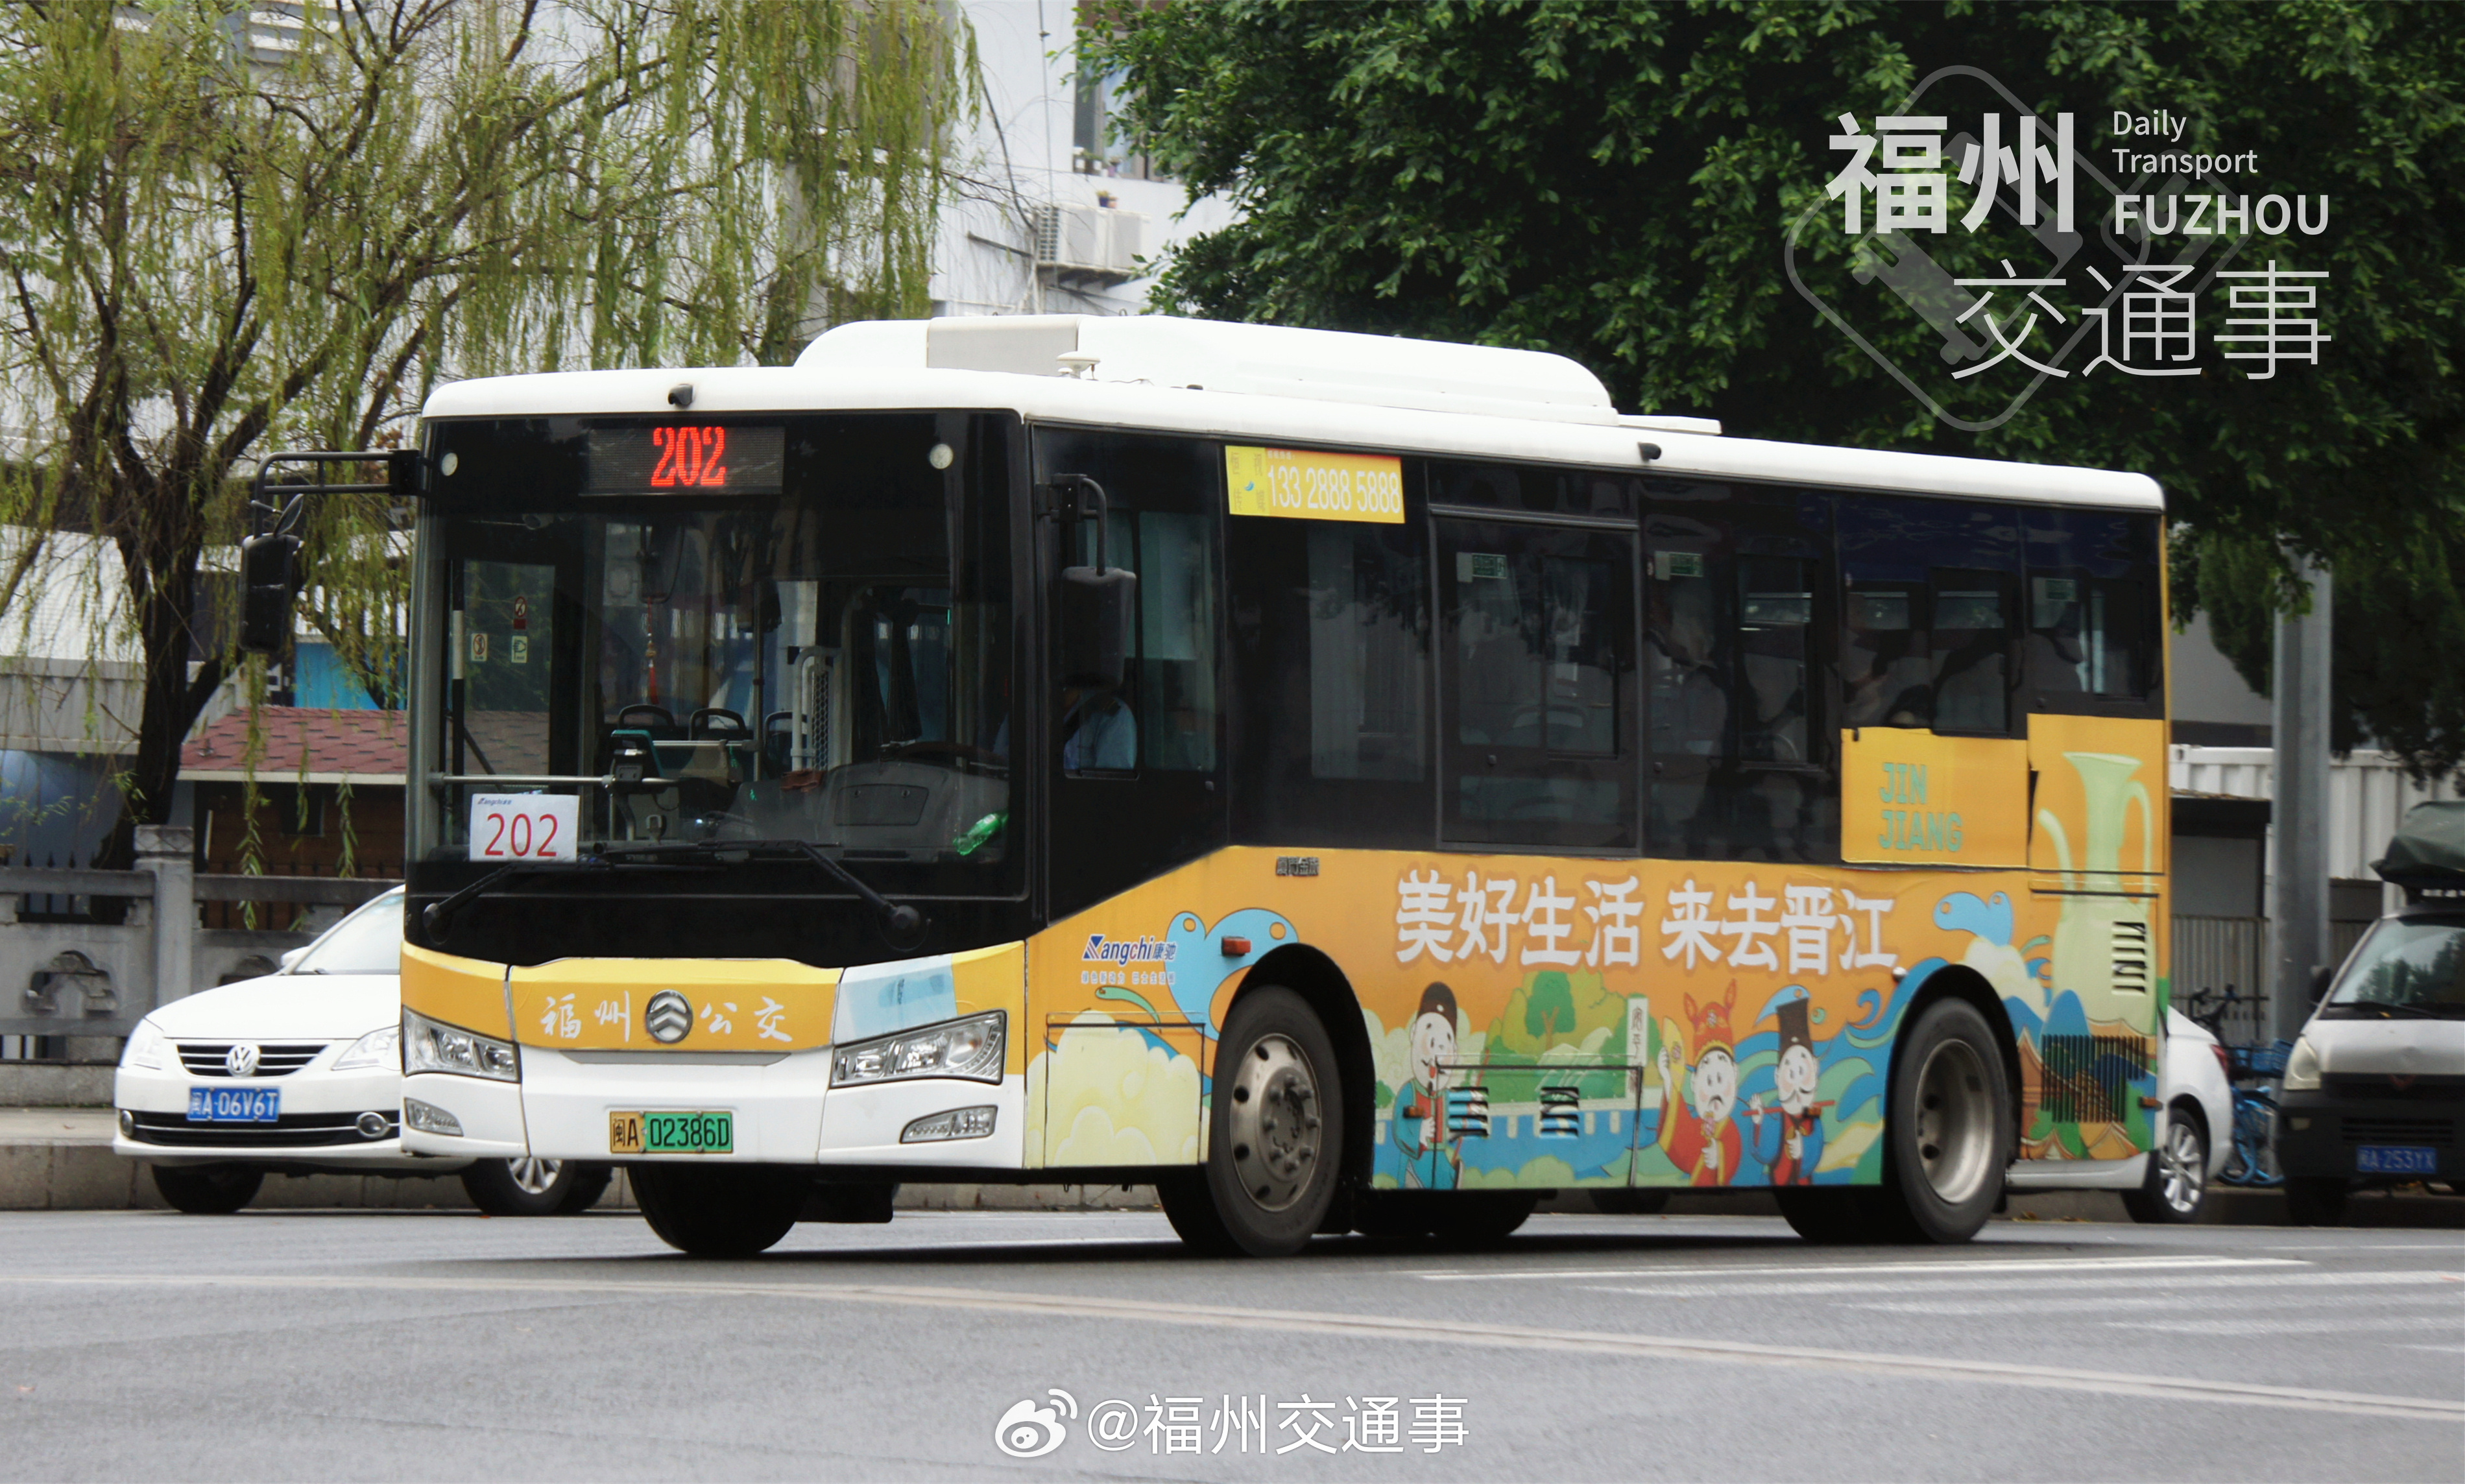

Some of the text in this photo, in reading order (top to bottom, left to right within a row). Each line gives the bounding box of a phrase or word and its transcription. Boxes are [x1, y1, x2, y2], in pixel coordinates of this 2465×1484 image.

[651, 426, 726, 486] 202
[1268, 465, 1301, 508] 133
[1306, 467, 1351, 511] 2888
[1357, 470, 1401, 513] 5888
[1881, 762, 1927, 804] JIN
[485, 813, 559, 857] 202
[1879, 810, 1962, 852] JIANG
[1396, 869, 1897, 975] 美好生活 来去晋江
[1083, 935, 1153, 965] Kangchi
[540, 990, 793, 1042] 福州 公交
